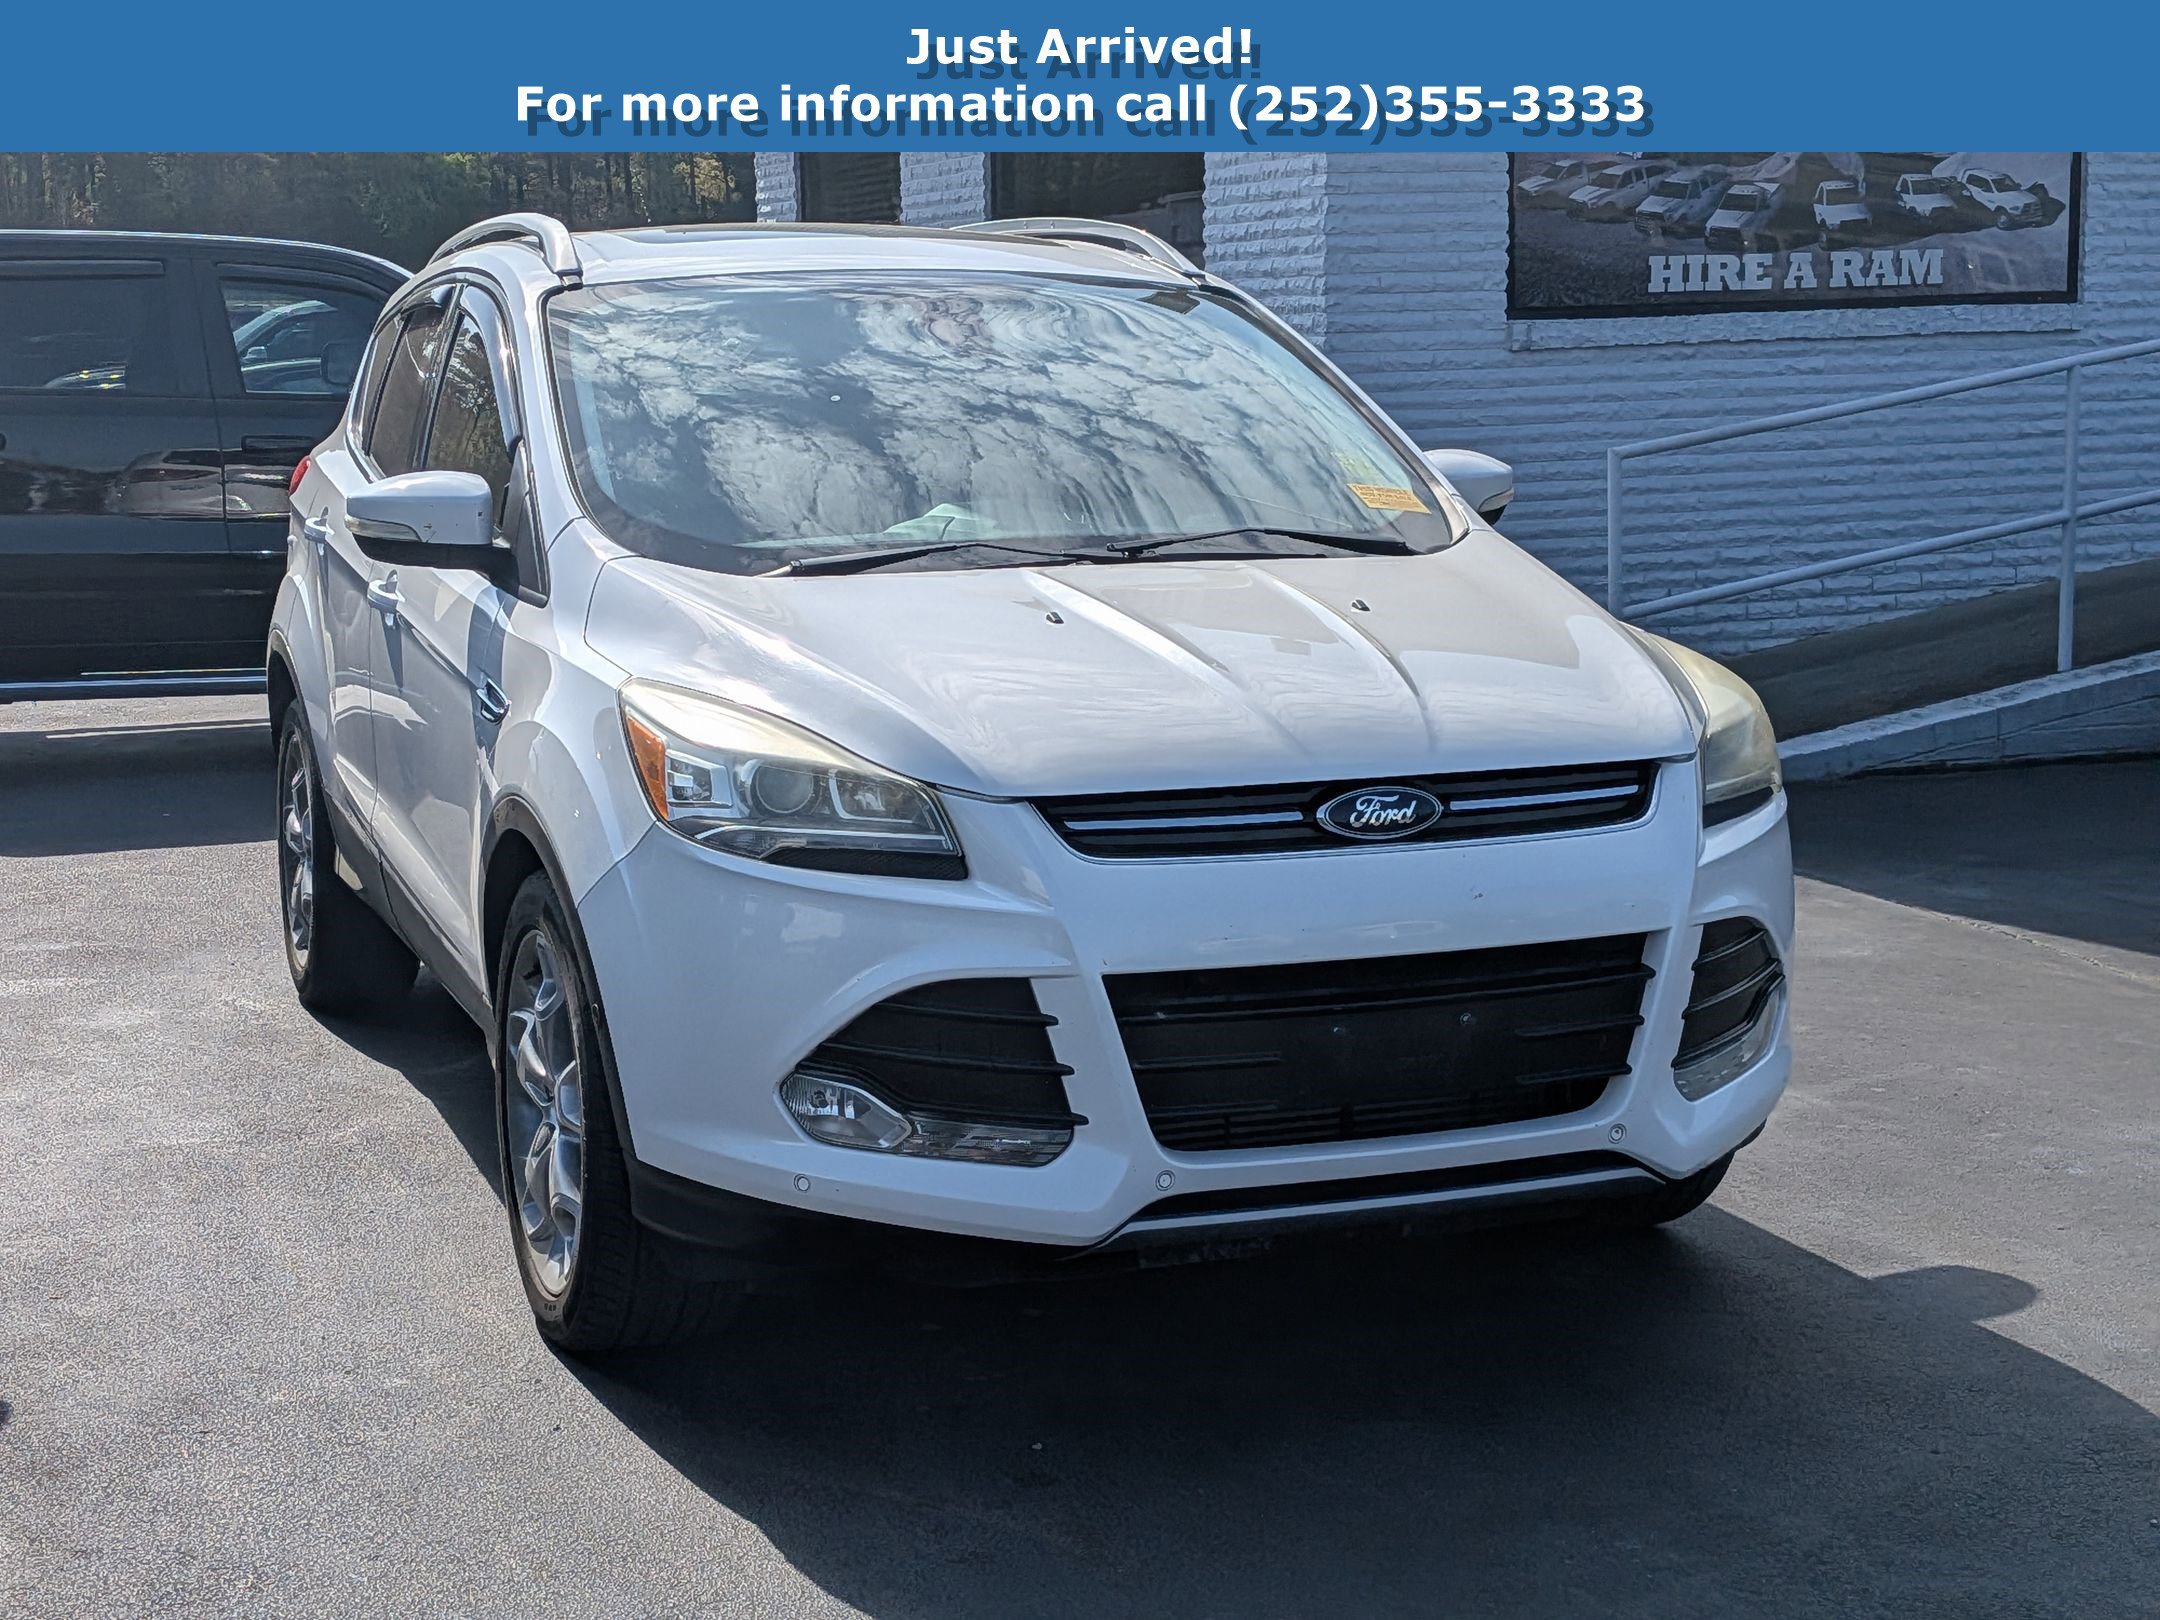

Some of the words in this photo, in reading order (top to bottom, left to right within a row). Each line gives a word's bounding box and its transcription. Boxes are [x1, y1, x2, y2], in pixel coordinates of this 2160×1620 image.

[1648, 253, 1773, 293] HIRE
[1784, 252, 1818, 289] A
[1829, 249, 1944, 288] RAM
[1349, 795, 1417, 828] Ford
